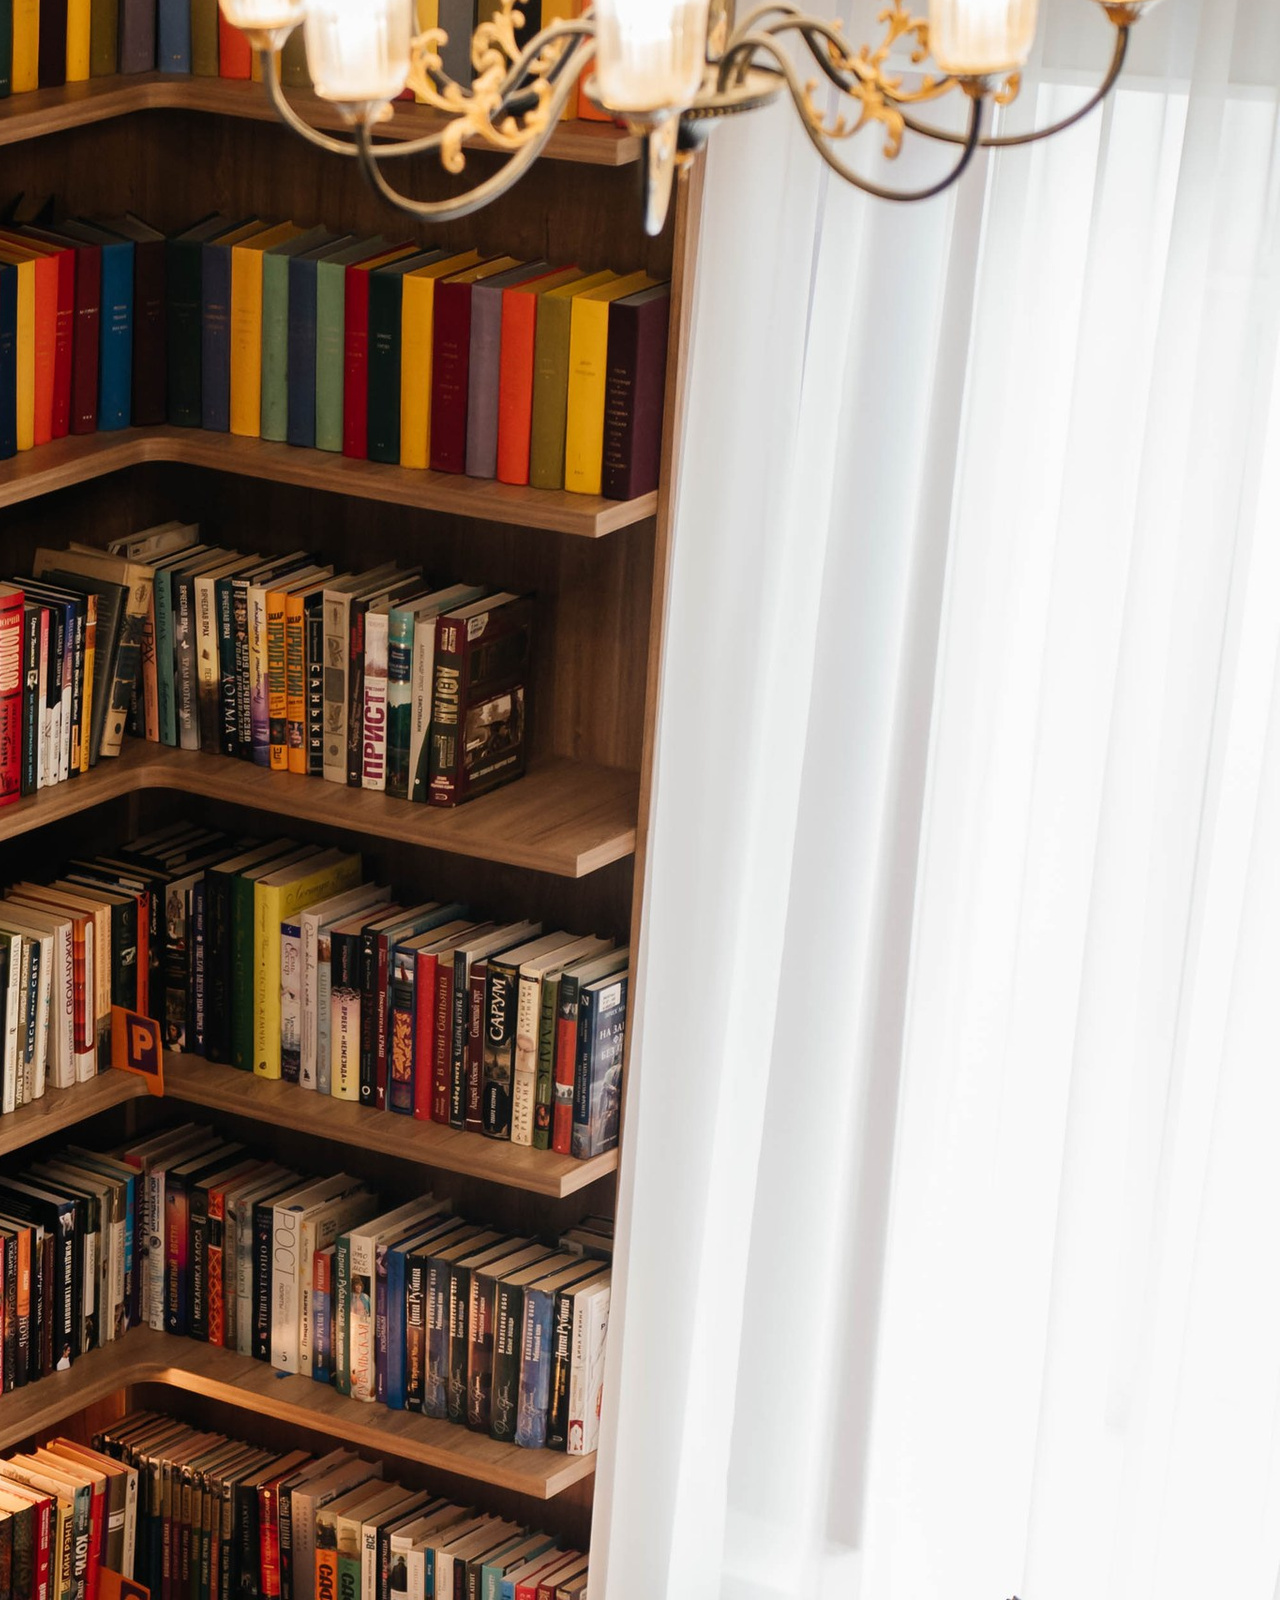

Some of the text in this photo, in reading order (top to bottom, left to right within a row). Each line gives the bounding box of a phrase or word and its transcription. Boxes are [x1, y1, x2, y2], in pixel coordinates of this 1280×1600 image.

[0, 627, 19, 692] ПОЛЯКОВ
[269, 622, 284, 693] ПРИЛЕПИН
[287, 626, 303, 697] ПРИЛЕПИН
[222, 672, 236, 734] ДОГМА
[435, 666, 459, 725] АФГАН
[362, 691, 385, 780] ПРИСТ
[64, 928, 74, 1015] СВОИ-ЧУЖИЕ
[132, 1025, 153, 1061] Р
[436, 976, 447, 1065] тени баньяна
[470, 1005, 480, 1038] Солнечный
[599, 1028, 611, 1040] НА
[170, 1224, 179, 1312] АБСОЛЮТНЫЙ ДОСТУП
[194, 1229, 202, 1320] МЕХАНИКА ХАОСА
[275, 1212, 295, 1283] РОСТ
[338, 1247, 347, 1326] Лариса Рубальская
[409, 1268, 423, 1329] Дина Рубина
[498, 1312, 506, 1354] НАПОЛЕОНОВ
[555, 1299, 570, 1361] Дина Рубина
[63, 1519, 72, 1578] АЙН РЭНД
